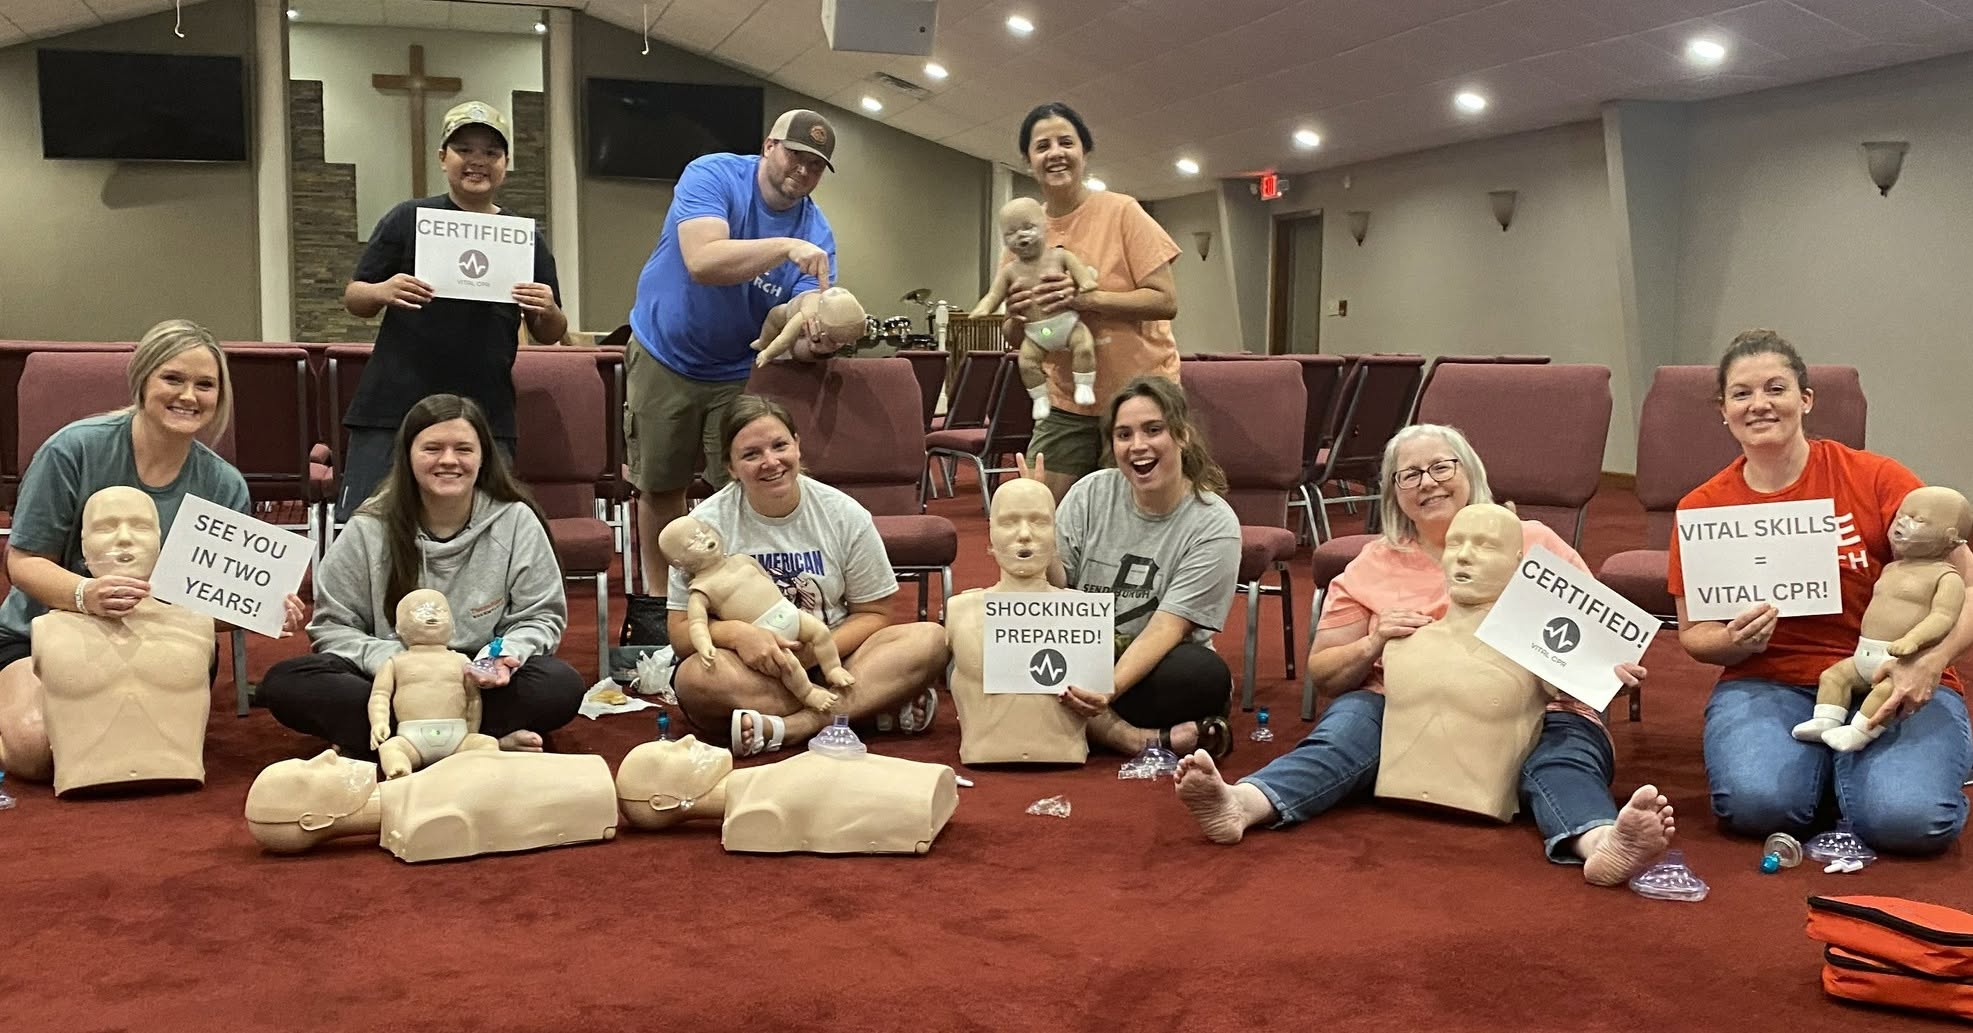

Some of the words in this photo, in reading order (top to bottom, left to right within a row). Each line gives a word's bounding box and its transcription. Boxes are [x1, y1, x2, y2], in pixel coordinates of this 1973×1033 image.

[417, 219, 534, 246] CERTIFIED!
[753, 276, 782, 297] RCH
[194, 514, 238, 542] SEE
[242, 529, 287, 559] YOU
[1679, 520, 1748, 541] VITAL
[1754, 515, 1836, 537] SKILLS
[191, 546, 217, 569] IN
[223, 556, 271, 587] TWO
[750, 550, 825, 576] MERICAN
[184, 576, 262, 617] YEARS!
[1521, 560, 1649, 649] CERTIFIED!
[1697, 584, 1766, 604] VITAL
[1772, 581, 1828, 602] CPR!
[986, 601, 1111, 617] SHOCKINGLY
[995, 629, 1101, 644] PREPARED!
